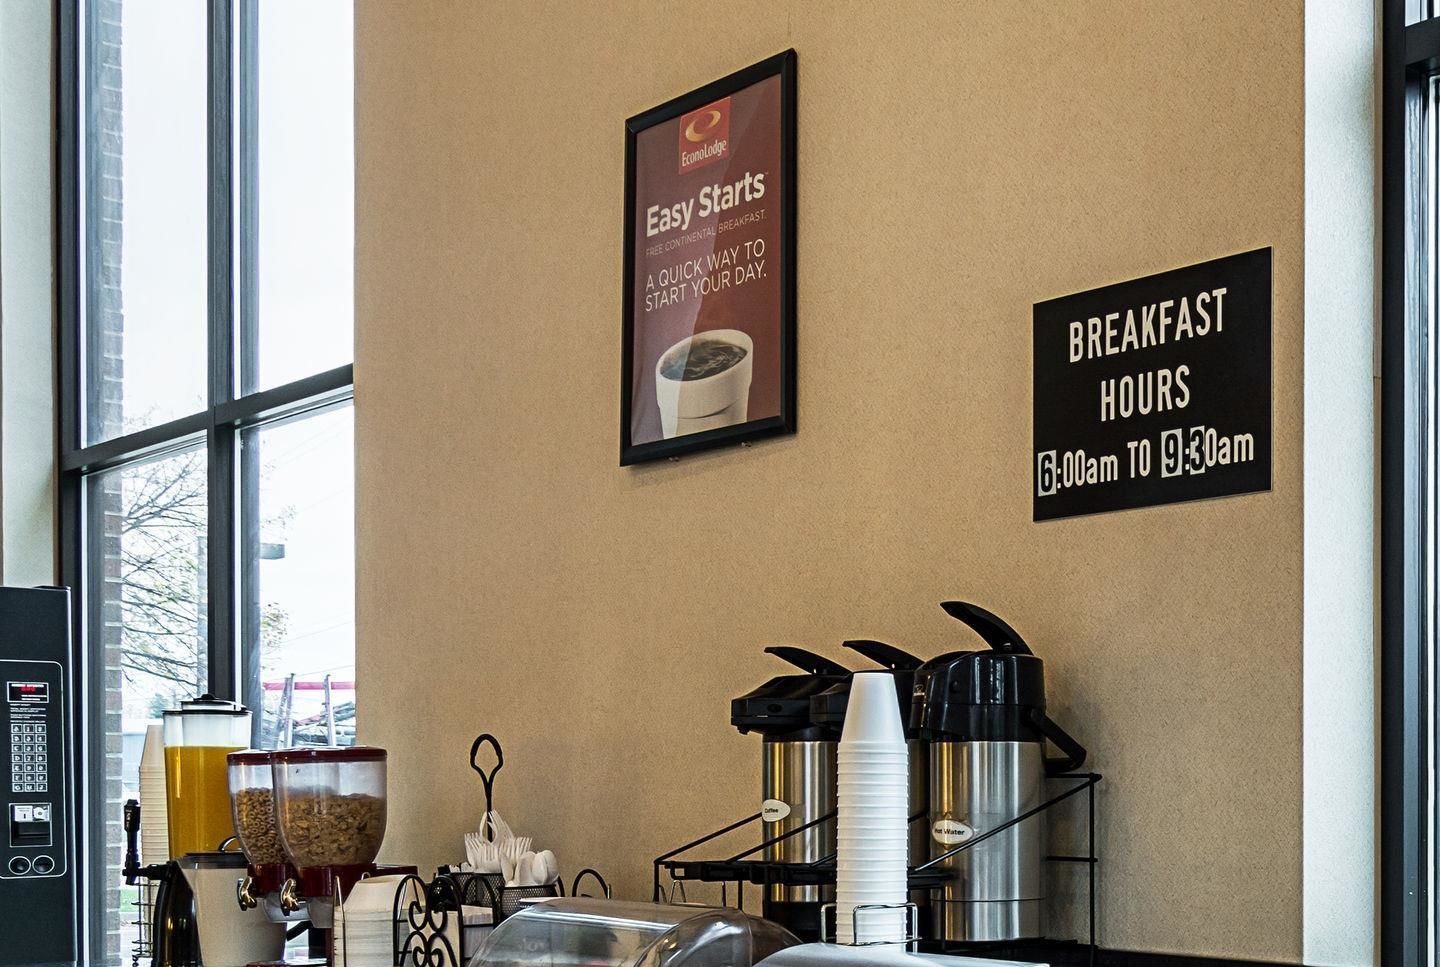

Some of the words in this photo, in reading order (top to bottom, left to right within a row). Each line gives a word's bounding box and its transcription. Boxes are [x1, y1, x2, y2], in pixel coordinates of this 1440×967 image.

[646, 198, 695, 238] Easy
[698, 171, 766, 218] Starts
[645, 274, 655, 292] A
[658, 258, 703, 287] QUICK
[707, 245, 740, 272] WAY
[744, 238, 765, 260] TO
[646, 244, 663, 257] FREE
[665, 226, 716, 251] CONTINENTAL
[645, 283, 687, 312] START
[691, 270, 731, 298] YOUR
[735, 260, 767, 286] DAY.
[1069, 287, 1228, 363] BREAKFAST
[1101, 364, 1191, 422] HOURS
[1038, 449, 1119, 497] 6:00am
[1127, 438, 1151, 479] TO
[1161, 425, 1255, 479] 9:30am
